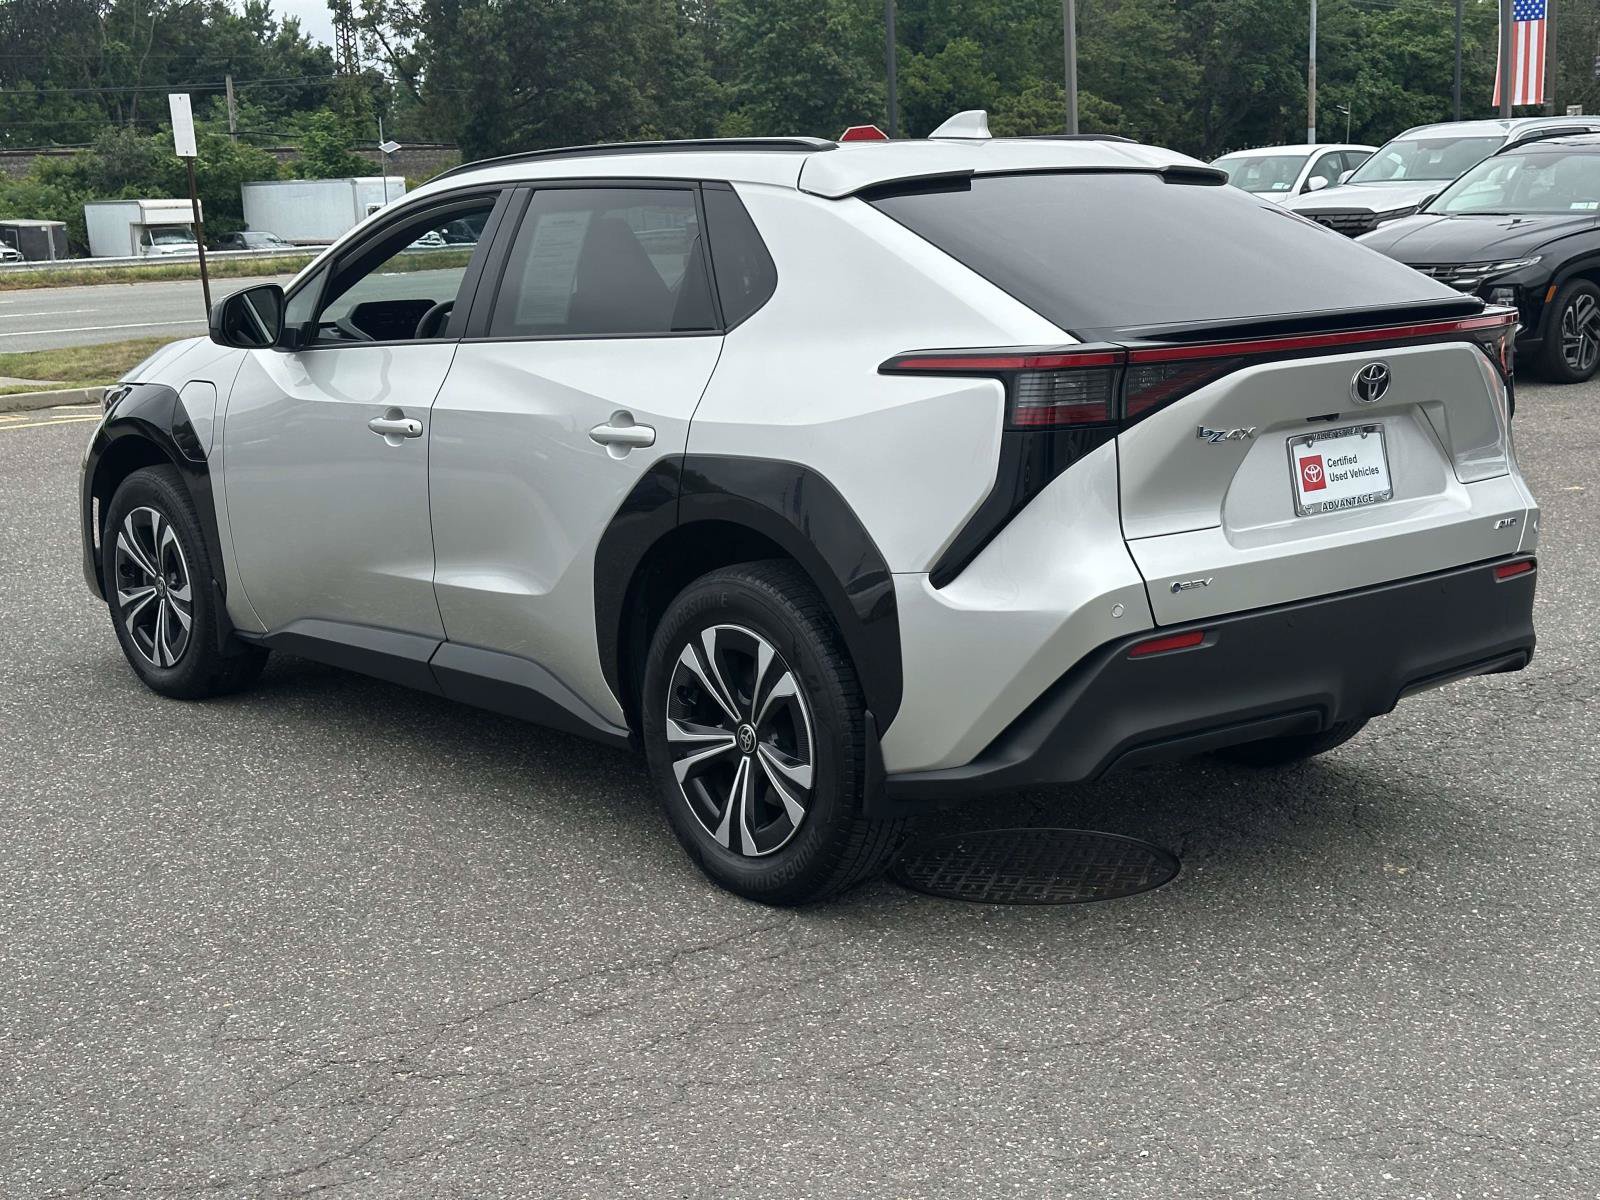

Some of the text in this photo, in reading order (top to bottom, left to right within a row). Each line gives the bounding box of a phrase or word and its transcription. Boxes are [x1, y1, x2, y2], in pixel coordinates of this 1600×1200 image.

[1327, 454, 1358, 468] Certified
[1329, 466, 1380, 482] Used Vehicles
[1321, 493, 1374, 512] ADVANTAGE
